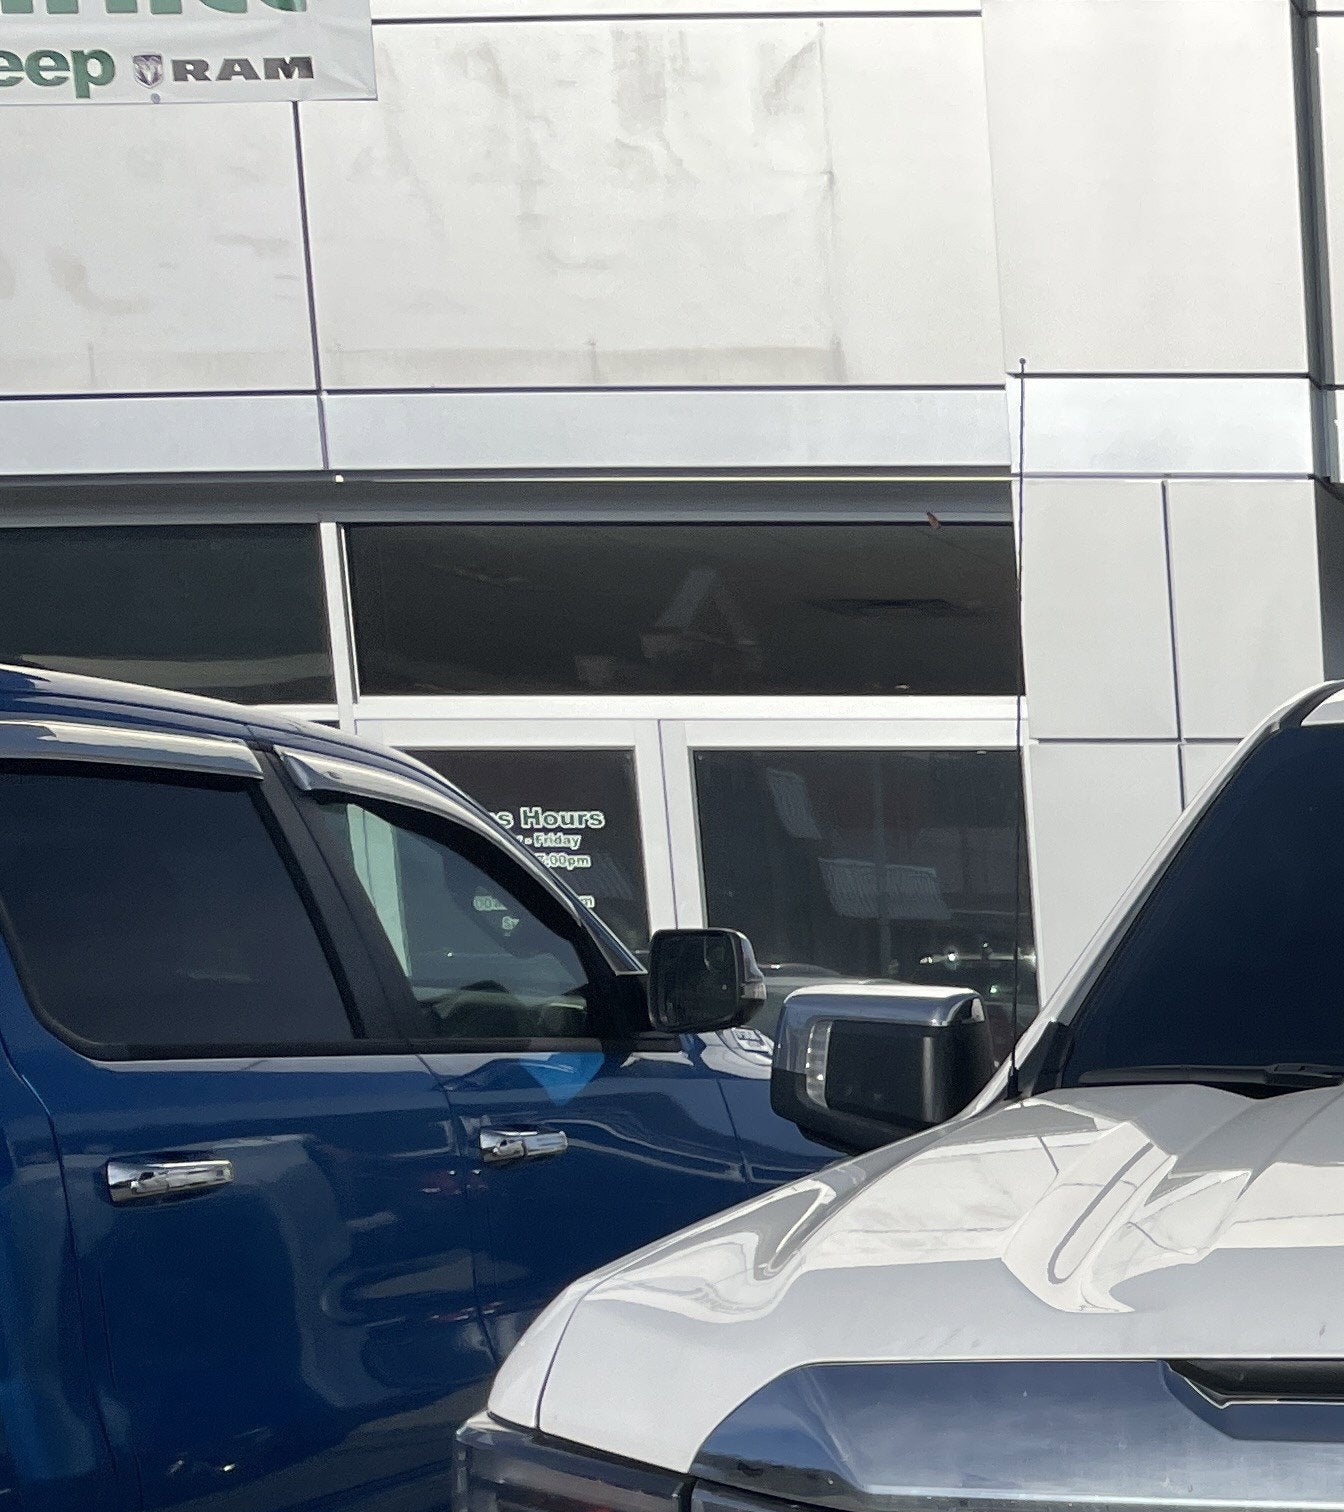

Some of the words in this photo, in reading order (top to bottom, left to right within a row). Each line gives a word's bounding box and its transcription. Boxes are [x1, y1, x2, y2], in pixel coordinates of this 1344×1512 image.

[0, 50, 115, 98] eep
[171, 56, 314, 82] RAM
[520, 807, 605, 828] Hours
[533, 833, 581, 849] Friday
